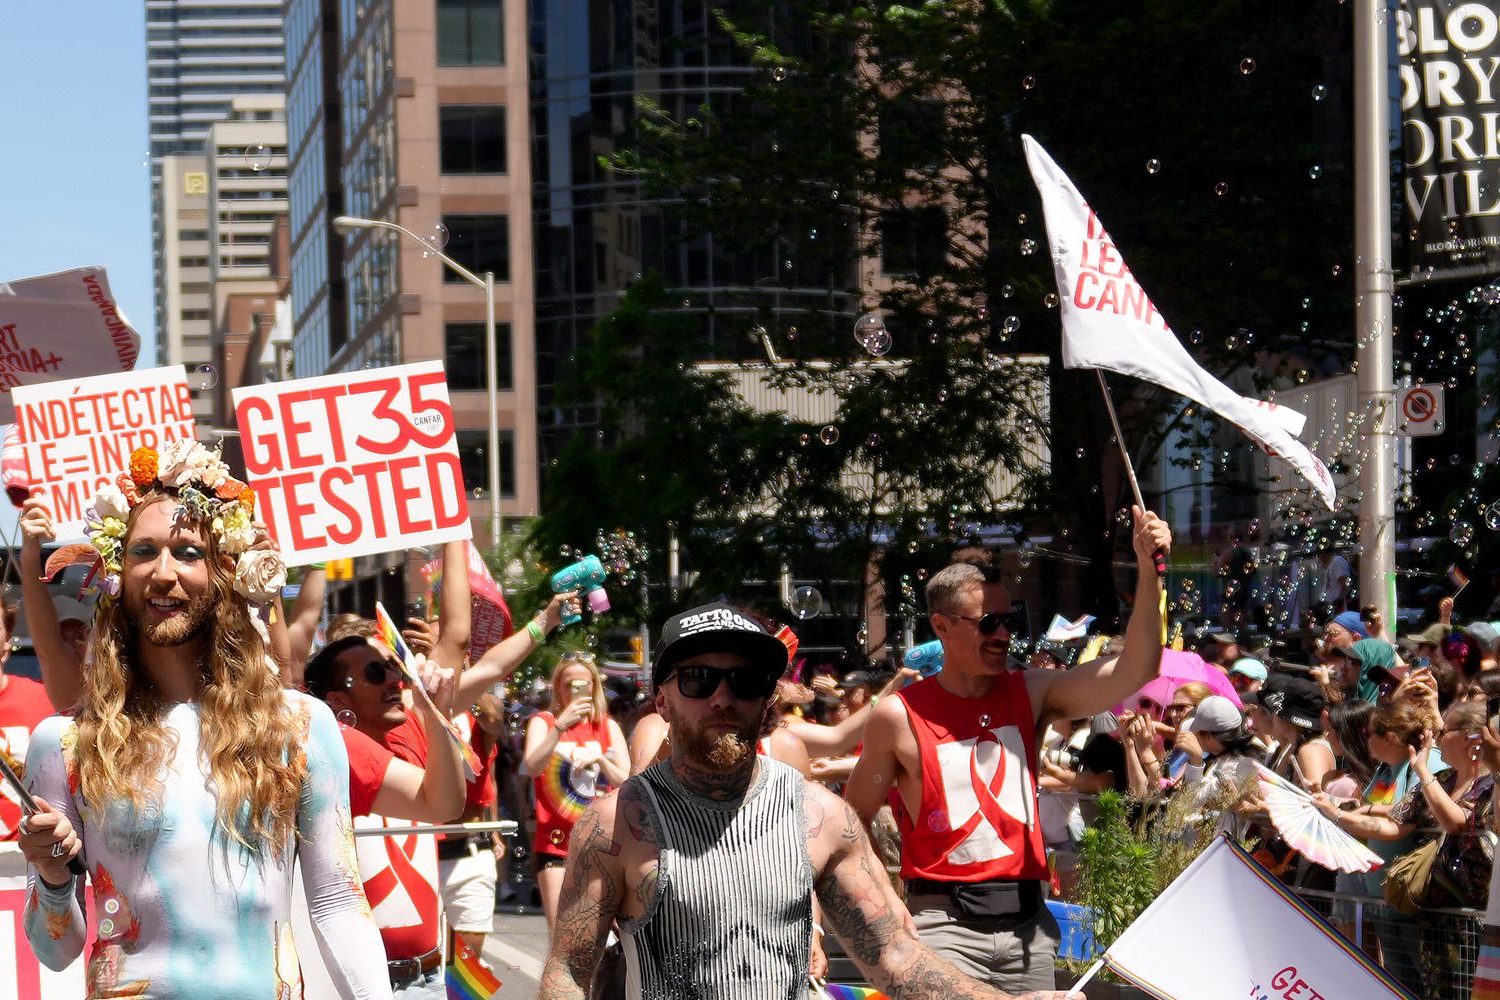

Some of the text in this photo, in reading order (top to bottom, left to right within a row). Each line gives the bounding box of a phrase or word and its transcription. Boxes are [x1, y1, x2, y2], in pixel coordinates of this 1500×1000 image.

[235, 371, 456, 476] GET 35
[414, 414, 442, 426] CANFAR
[250, 451, 470, 552] TESTED
[714, 619, 736, 630] AND
[1292, 715, 1313, 729] CANADA
